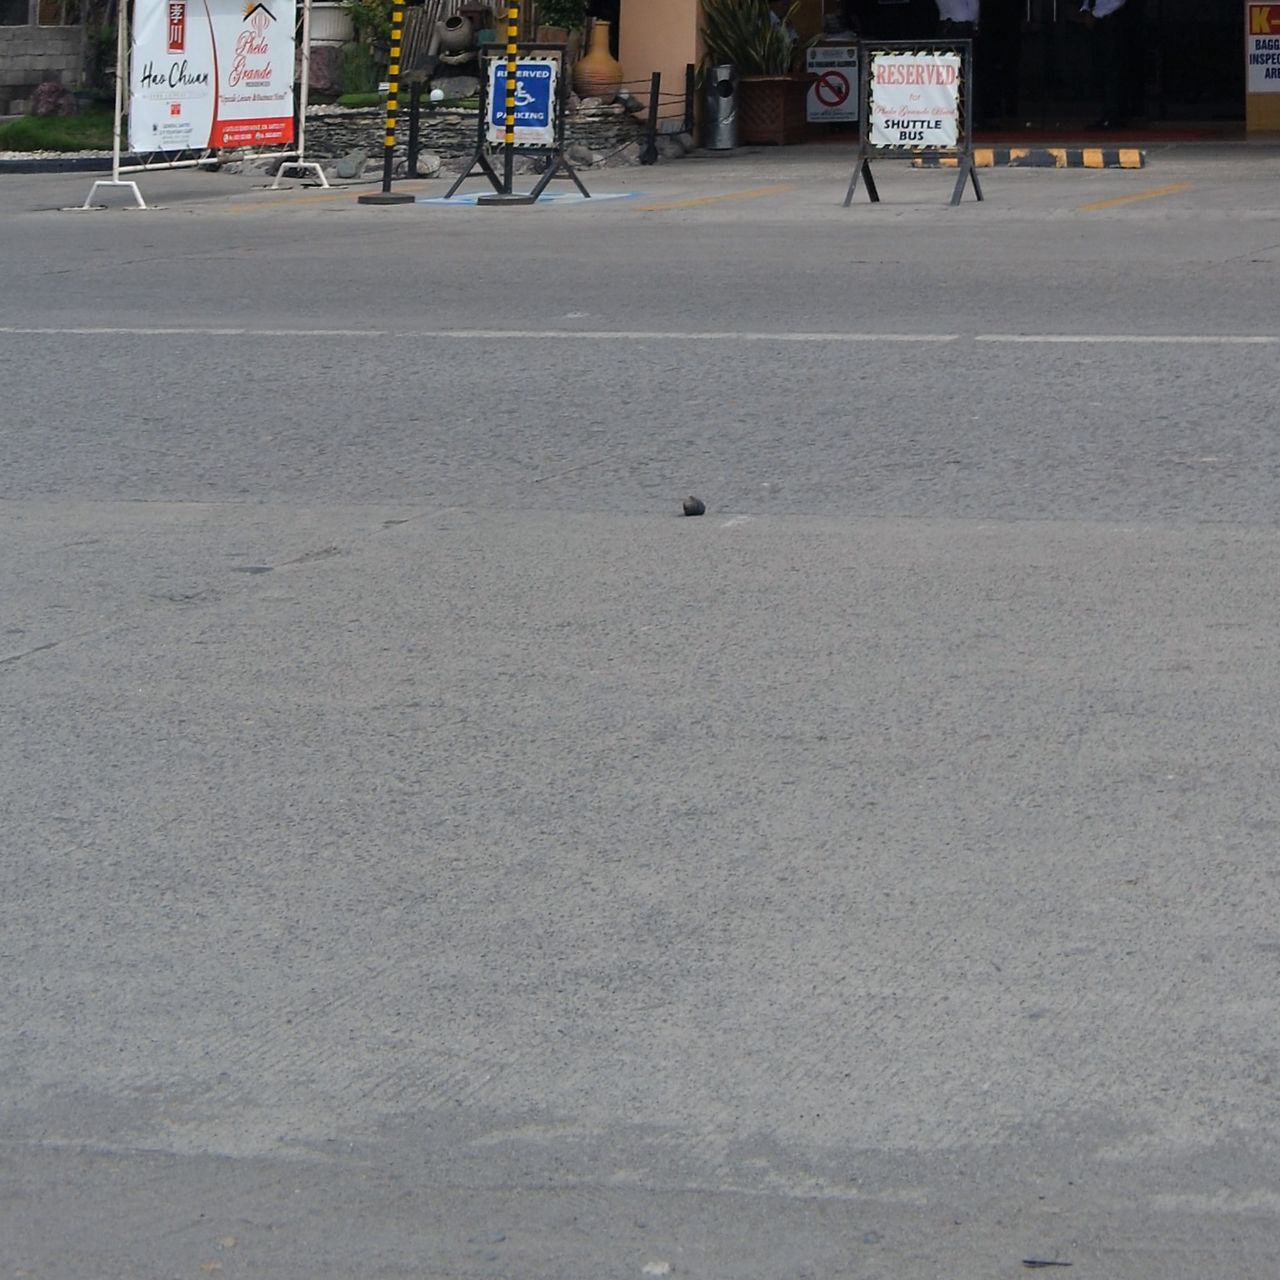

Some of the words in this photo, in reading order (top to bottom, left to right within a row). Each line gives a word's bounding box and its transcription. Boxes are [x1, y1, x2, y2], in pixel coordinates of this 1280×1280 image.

[235, 29, 269, 56] Phela
[140, 60, 166, 89] Hao
[168, 59, 209, 89] Chuan
[228, 55, 273, 88] Grande
[876, 64, 956, 85] RESERVED
[884, 119, 942, 130] SHUTTLE
[899, 131, 925, 141] BUS
